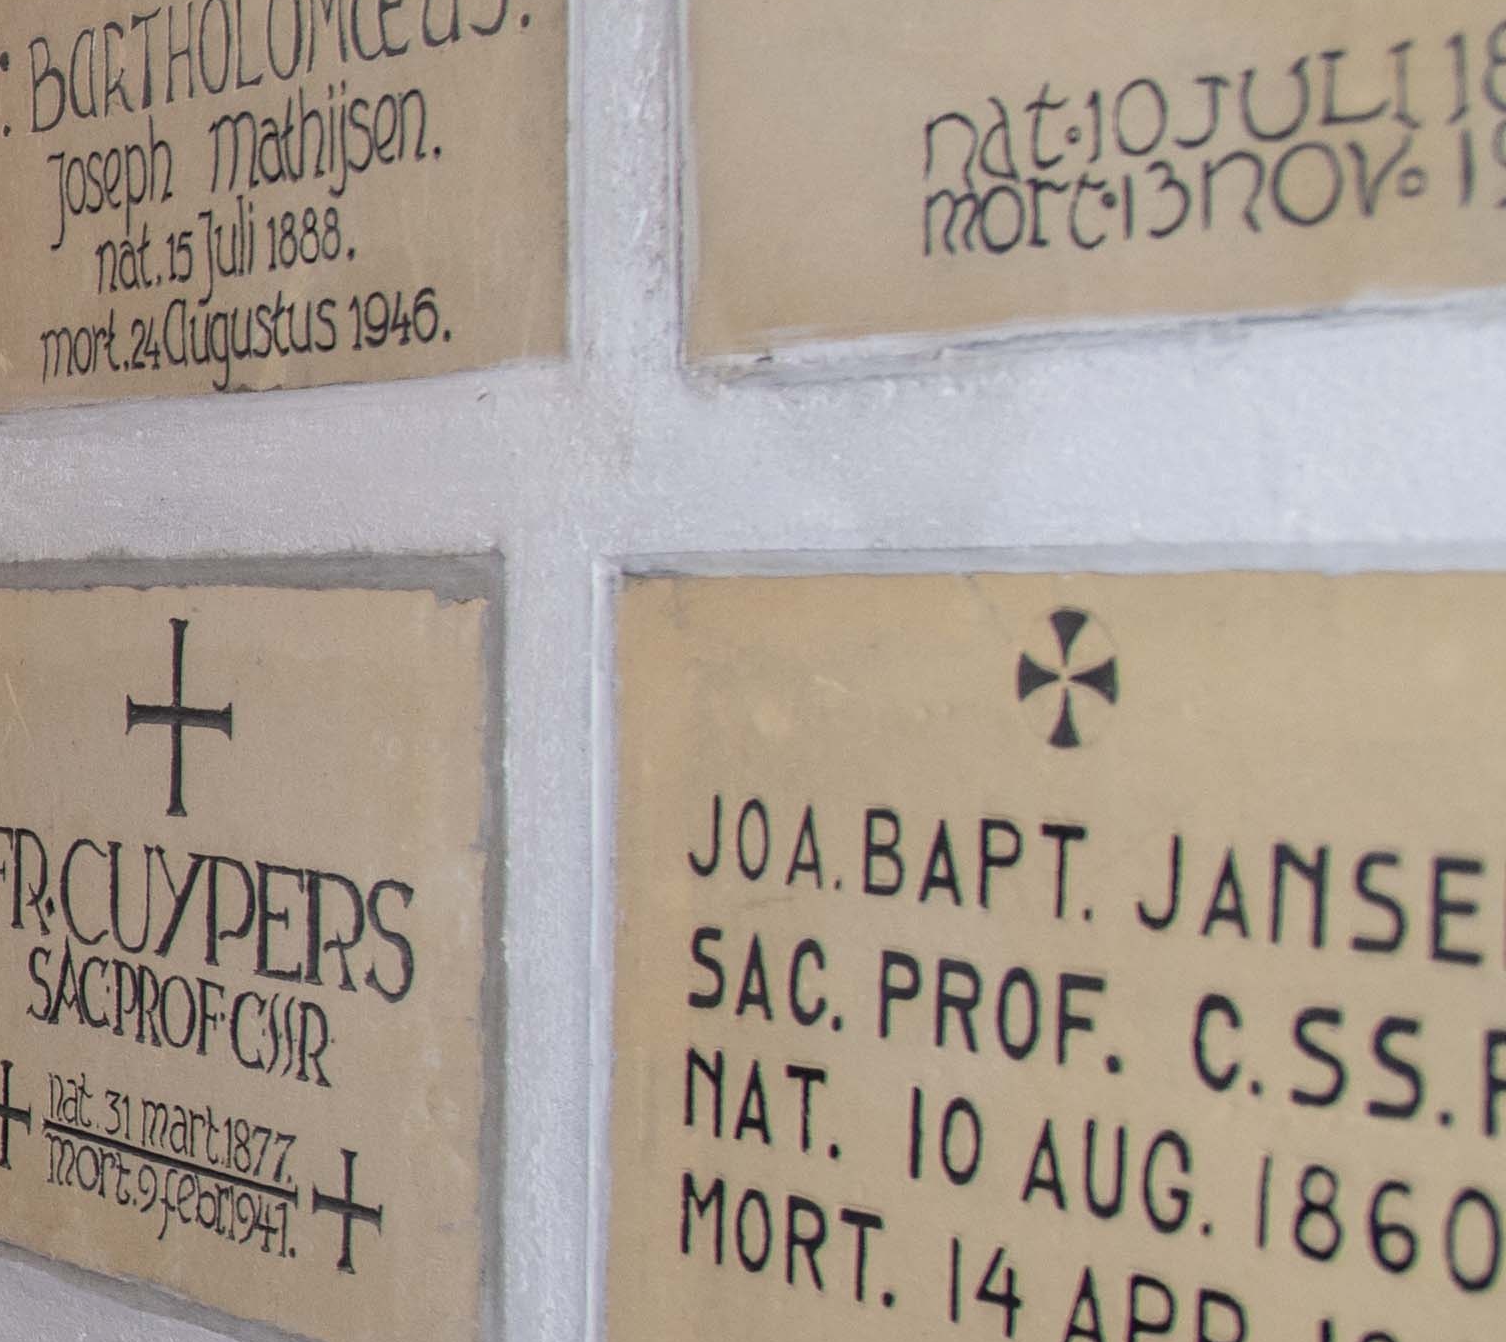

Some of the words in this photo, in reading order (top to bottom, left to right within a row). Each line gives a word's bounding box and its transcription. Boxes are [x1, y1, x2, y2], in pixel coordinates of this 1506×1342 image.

[46, 112, 174, 253] Joseph
[198, 194, 255, 307] Juli
[686, 925, 847, 1036] SAC.
[877, 950, 1124, 1076] PROF.
[683, 1045, 843, 1162] NAT.
[908, 1082, 984, 1186] 10
[1019, 1114, 1217, 1239] AUG.
[1252, 1151, 1506, 1296] 1860
[681, 1168, 899, 1311] MORT.
[947, 1233, 1025, 1340] 14
